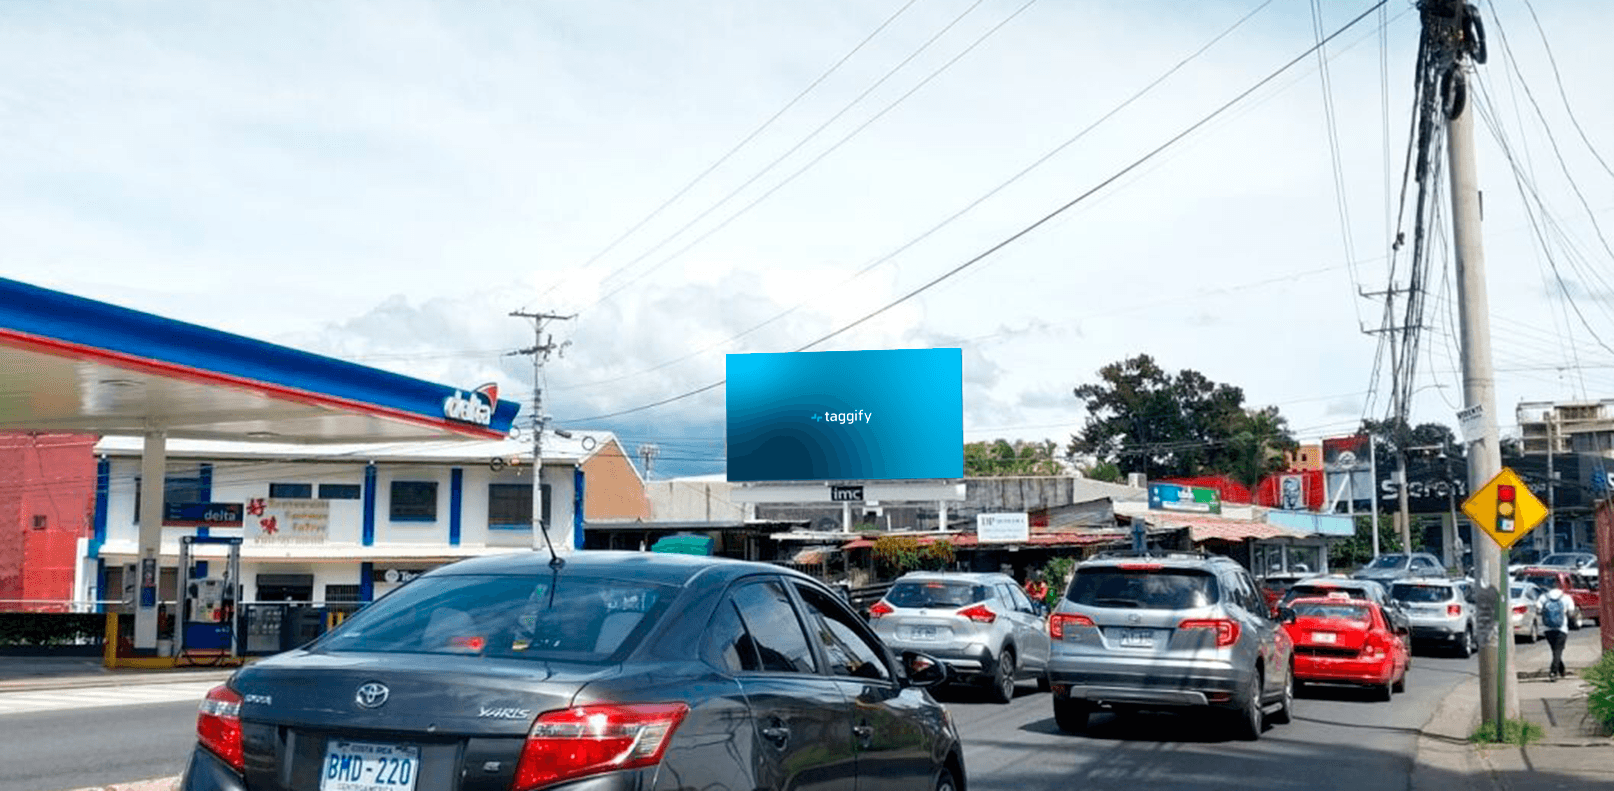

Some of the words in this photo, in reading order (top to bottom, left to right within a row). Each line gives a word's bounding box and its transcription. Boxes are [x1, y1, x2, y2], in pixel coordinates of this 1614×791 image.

[444, 389, 491, 426] delta
[824, 409, 872, 425] taggify
[832, 488, 861, 500] imc
[203, 509, 236, 521] delta
[478, 706, 531, 719] YARIS
[327, 753, 412, 785] BMD-220
